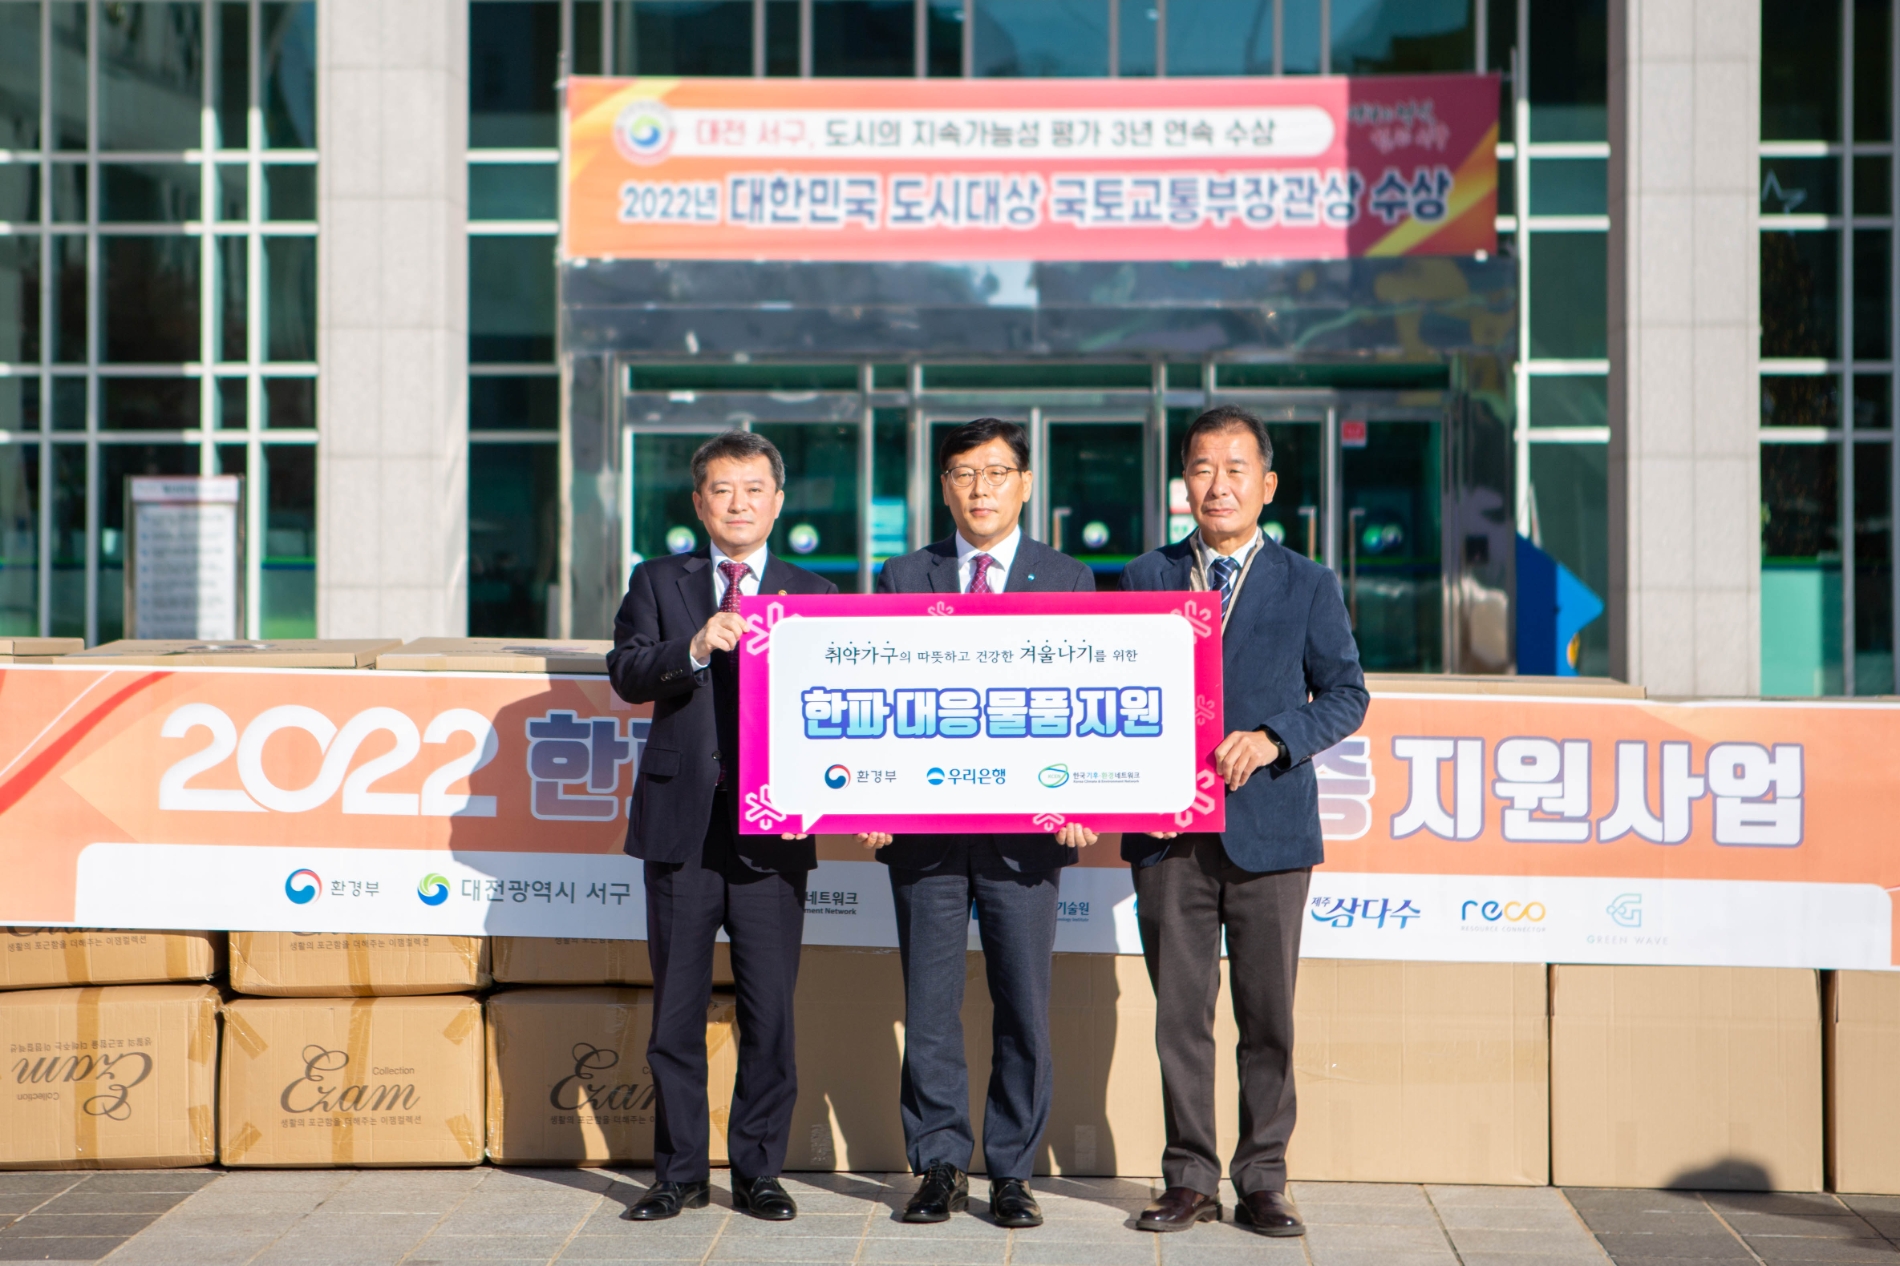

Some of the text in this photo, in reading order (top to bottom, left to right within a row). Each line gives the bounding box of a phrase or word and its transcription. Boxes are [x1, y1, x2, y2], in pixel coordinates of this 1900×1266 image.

[697, 119, 1276, 149] 대전 서구, 도시의 지속가능성 평가 3년 연속 수상
[622, 168, 1452, 224] 2022년 대한민국 도시대상 국토교통부장관상 수상
[825, 642, 1138, 665] 취약가구의 따뜻하고 건강한 겨울나기를 위한
[802, 686, 1163, 740] 한파 대응 물품 지원
[158, 702, 500, 817] 2022
[525, 709, 651, 821] 한
[857, 769, 897, 784] 환경부
[948, 768, 1006, 785] 우리은행
[1390, 735, 1804, 848] 지원사업
[330, 880, 380, 898] 환경부
[460, 878, 631, 905] 대전광역시 서구
[1057, 901, 1089, 916] 기술원
[1311, 896, 1331, 907] 제주
[1461, 900, 1546, 922] reco
[1311, 897, 1421, 929] 삼다수
[1587, 935, 1669, 945] GREEN WAVE
[280, 1044, 420, 1113] Ezam
[372, 1067, 415, 1075] Collection
[17, 1092, 59, 1101] Collection
[281, 1118, 305, 1128] 생활의
